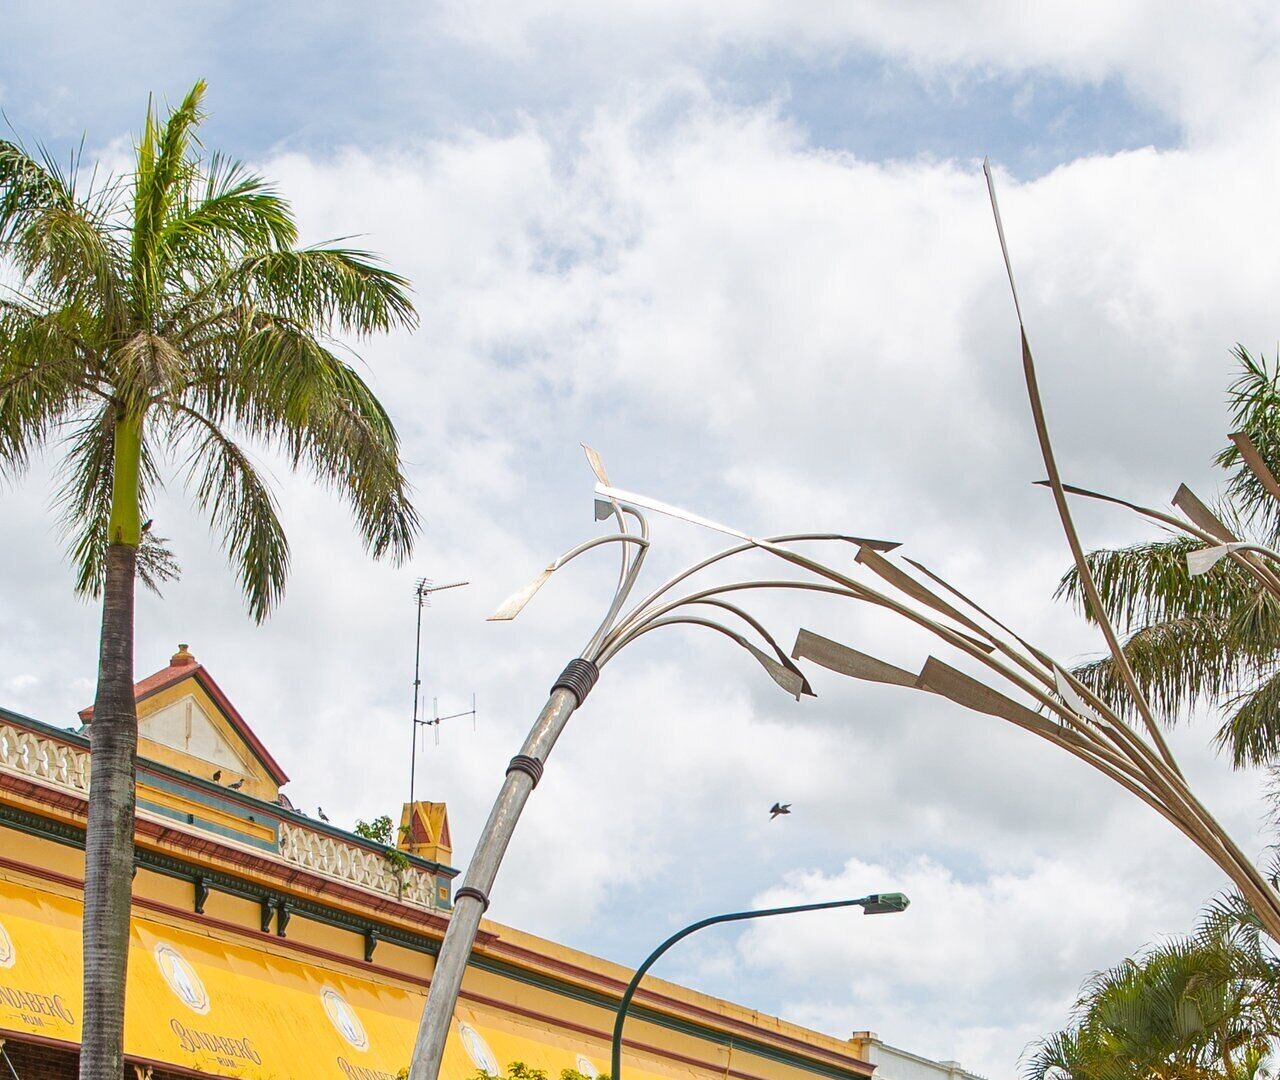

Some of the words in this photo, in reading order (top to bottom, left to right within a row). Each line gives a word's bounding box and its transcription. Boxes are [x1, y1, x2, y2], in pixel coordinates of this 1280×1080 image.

[21, 1013, 45, 1028] RUM
[170, 1018, 262, 1066] BUNDABERG
[217, 1056, 238, 1069] RUM
